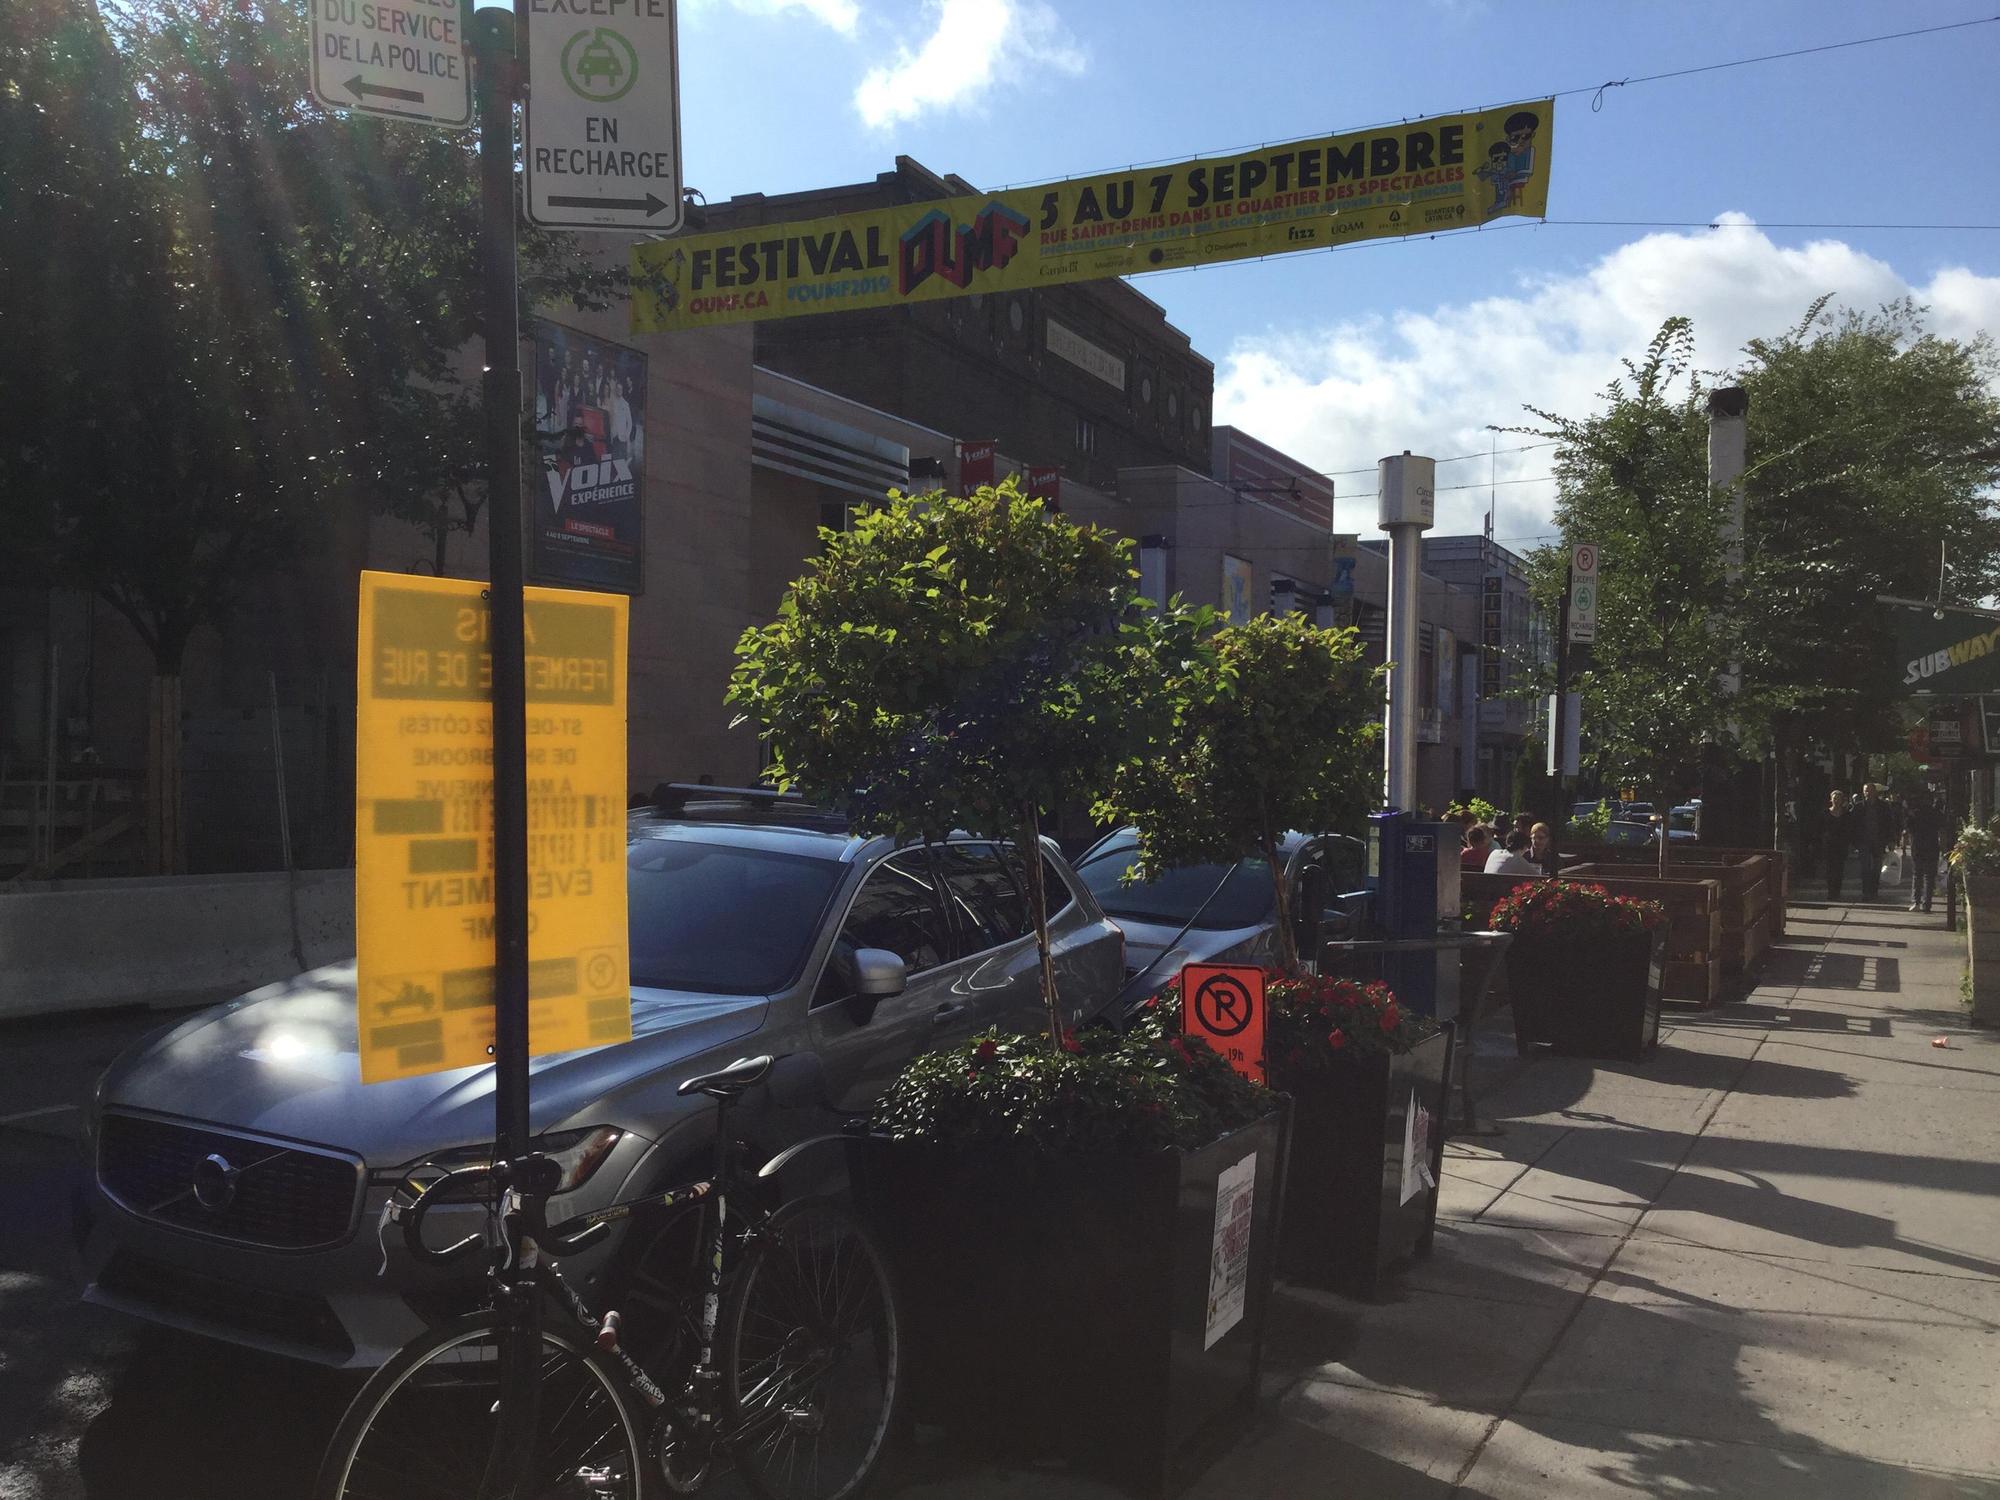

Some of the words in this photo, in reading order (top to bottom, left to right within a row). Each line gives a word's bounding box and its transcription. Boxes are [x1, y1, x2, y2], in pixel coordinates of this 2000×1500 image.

[325, 0, 355, 25] DU
[362, 4, 457, 45] SERVICE
[325, 33, 351, 61] DE
[356, 38, 384, 67] LA
[388, 44, 459, 80] POLICE
[586, 117, 618, 143] EN
[536, 148, 670, 178] RECHARGE
[1040, 192, 1058, 230] 5
[1073, 181, 1134, 225] AU
[1149, 174, 1173, 213] 7
[1188, 124, 1464, 207] SEPTEMBRE
[1041, 226, 1067, 244] RUE
[1072, 213, 1165, 241] SAINT-DENIS
[1169, 208, 1210, 225] DANS
[1216, 203, 1232, 218] LE
[1237, 190, 1318, 215] QUARTIER
[1325, 184, 1354, 202] DES
[1359, 167, 1465, 194] SPECTACLES
[691, 226, 889, 290] FESTIVAL
[689, 290, 769, 315] OUMF.CA
[1902, 626, 2000, 686] SUBWAY
